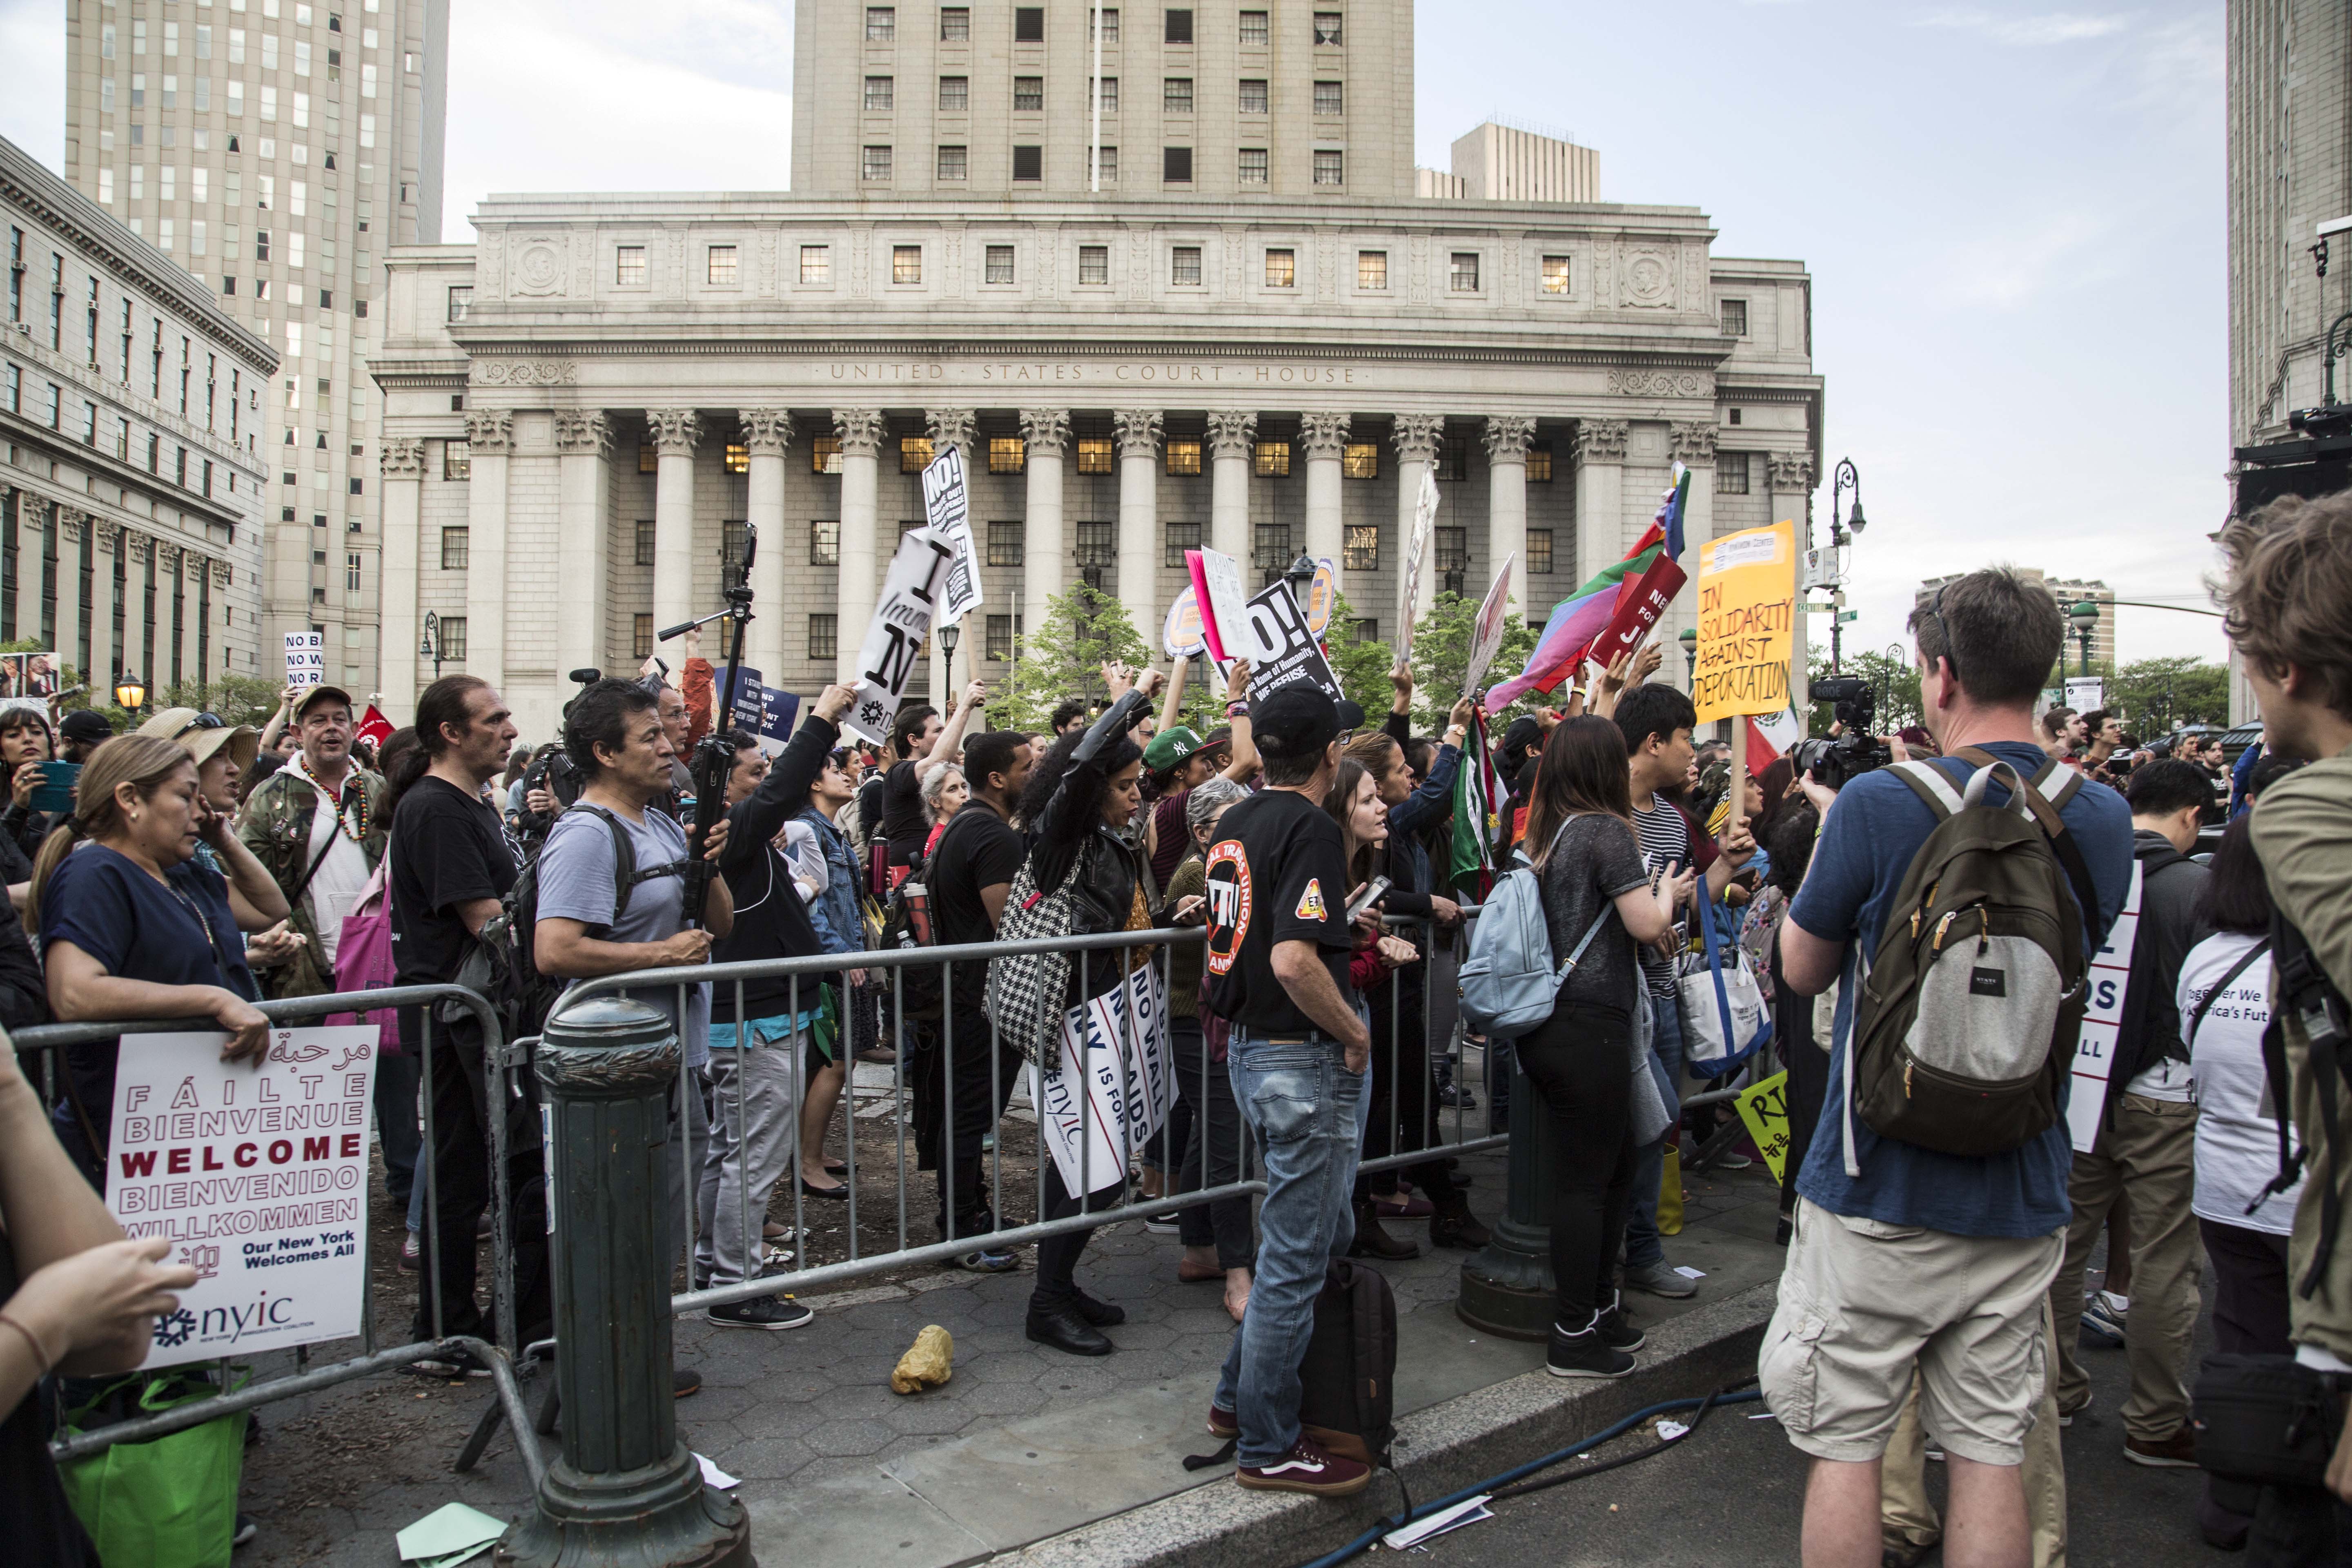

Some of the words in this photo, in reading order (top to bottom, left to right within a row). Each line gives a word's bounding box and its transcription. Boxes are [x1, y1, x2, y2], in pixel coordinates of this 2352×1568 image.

[831, 364, 944, 380] UNITED
[982, 365, 1083, 381] STATES
[1116, 365, 1225, 382] COURT
[1256, 366, 1355, 383] HOUSE
[925, 450, 961, 504] NO!
[947, 485, 962, 500] OUT
[1702, 581, 1723, 614] IN
[1800, 604, 1825, 612] CENTRE
[1638, 606, 1655, 624] FOR
[1700, 597, 1794, 643] SOLIDARITY
[287, 636, 304, 647] NO
[1698, 637, 1773, 671] AGAINST
[287, 655, 304, 665] NO
[1254, 670, 1273, 687] Name
[1272, 663, 1279, 676] of
[1278, 646, 1315, 671] Humanity,
[289, 673, 305, 684] NO
[1695, 658, 1791, 706] DEPORTATION
[1173, 741, 1189, 756] NY
[1236, 874, 1250, 935] UNION
[2240, 989, 2261, 1002] We
[2187, 1004, 2240, 1019] Arica's
[2243, 1008, 2268, 1022] Fut
[1133, 969, 1151, 1019] NO
[1144, 1024, 1163, 1116] WALL
[1070, 1005, 1107, 1050] NY
[1097, 1066, 1114, 1086] IS
[1107, 1088, 1125, 1126] FOR
[126, 1073, 366, 1112] FÁILTE
[124, 1101, 363, 1143] BIENVENUE
[120, 1134, 361, 1178] WELCOME
[1052, 1116, 1066, 1142] IMMIGRATION
[1064, 1143, 1075, 1164] COALITION
[119, 1165, 359, 1215] BIENVENIDO
[121, 1198, 358, 1243] WILLKOMMEN
[242, 1242, 274, 1256] Our
[278, 1235, 315, 1251] New
[320, 1230, 354, 1245] York
[245, 1247, 328, 1270] Welcomes
[334, 1243, 355, 1257] All
[201, 1290, 293, 1344] nyic
[241, 1326, 281, 1336] IMMIGRATION
[283, 1321, 315, 1330] COALITION
